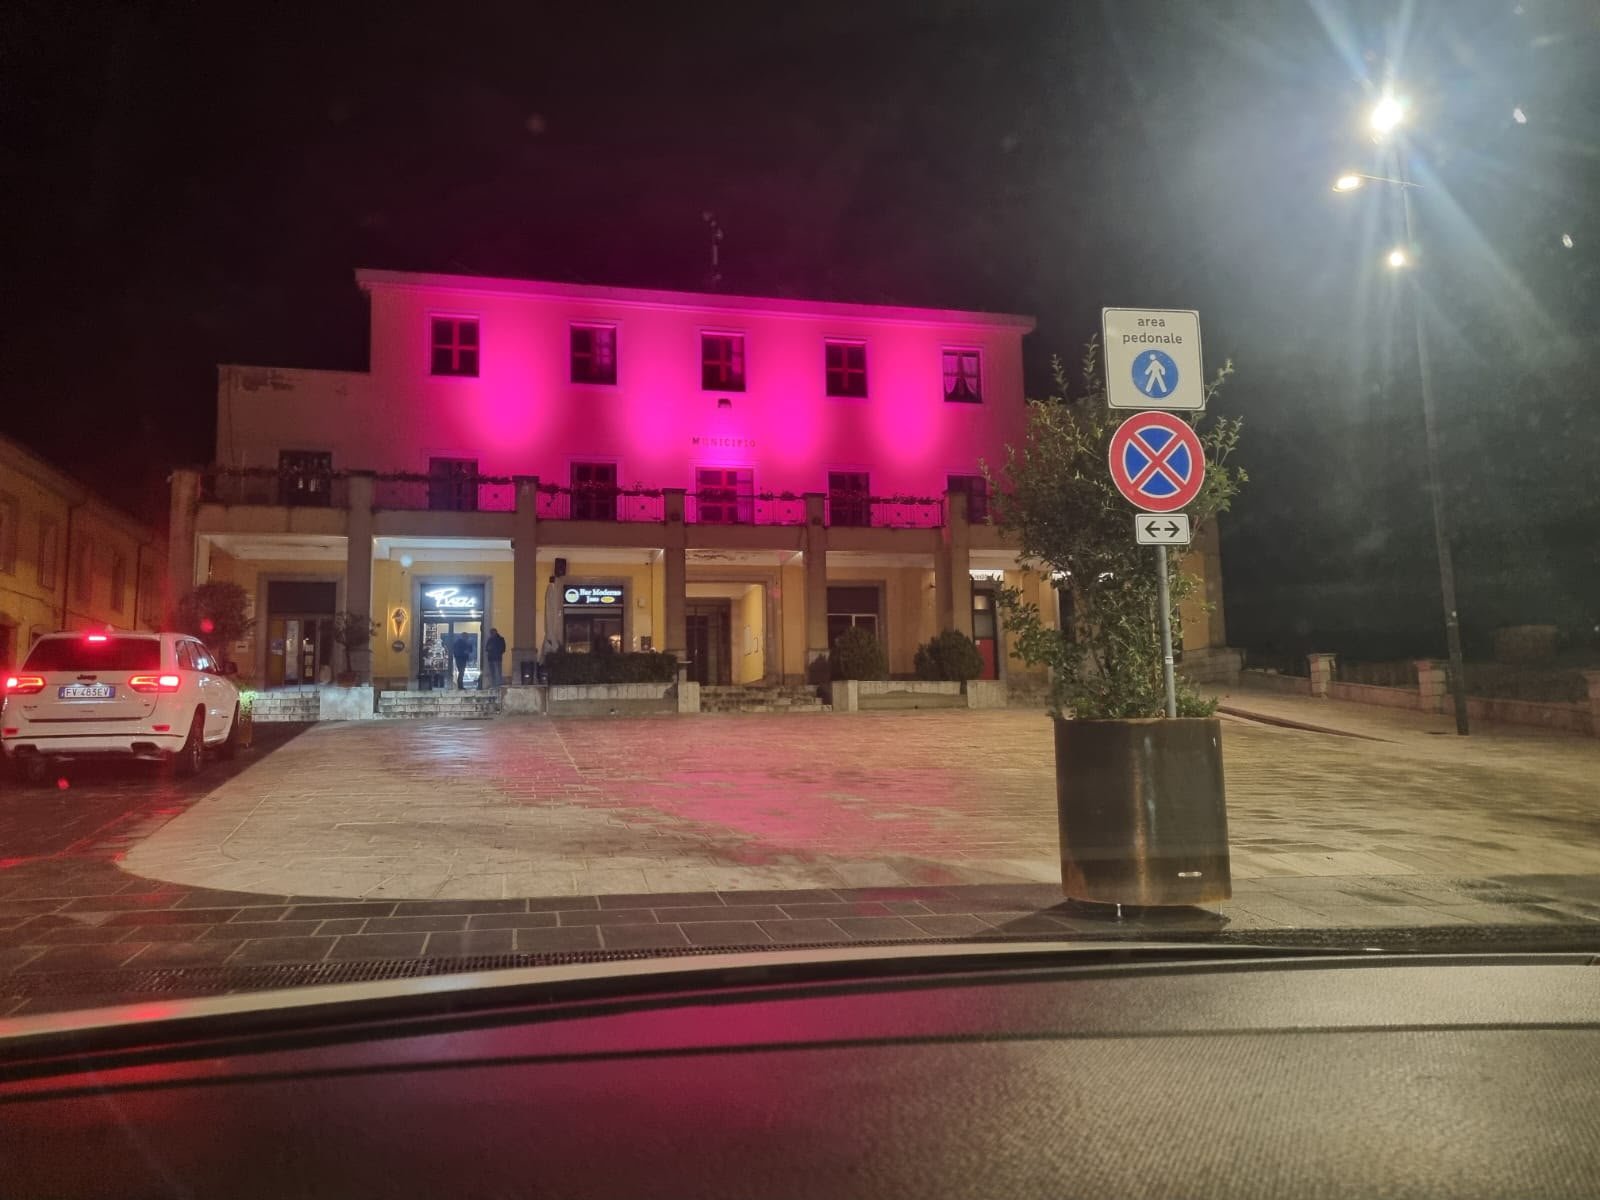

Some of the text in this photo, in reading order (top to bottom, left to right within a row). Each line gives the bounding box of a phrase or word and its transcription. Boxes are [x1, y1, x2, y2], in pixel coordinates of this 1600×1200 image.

[1137, 318, 1166, 327] area
[1122, 333, 1183, 345] pedonale
[692, 437, 756, 448] MUNICIPIO
